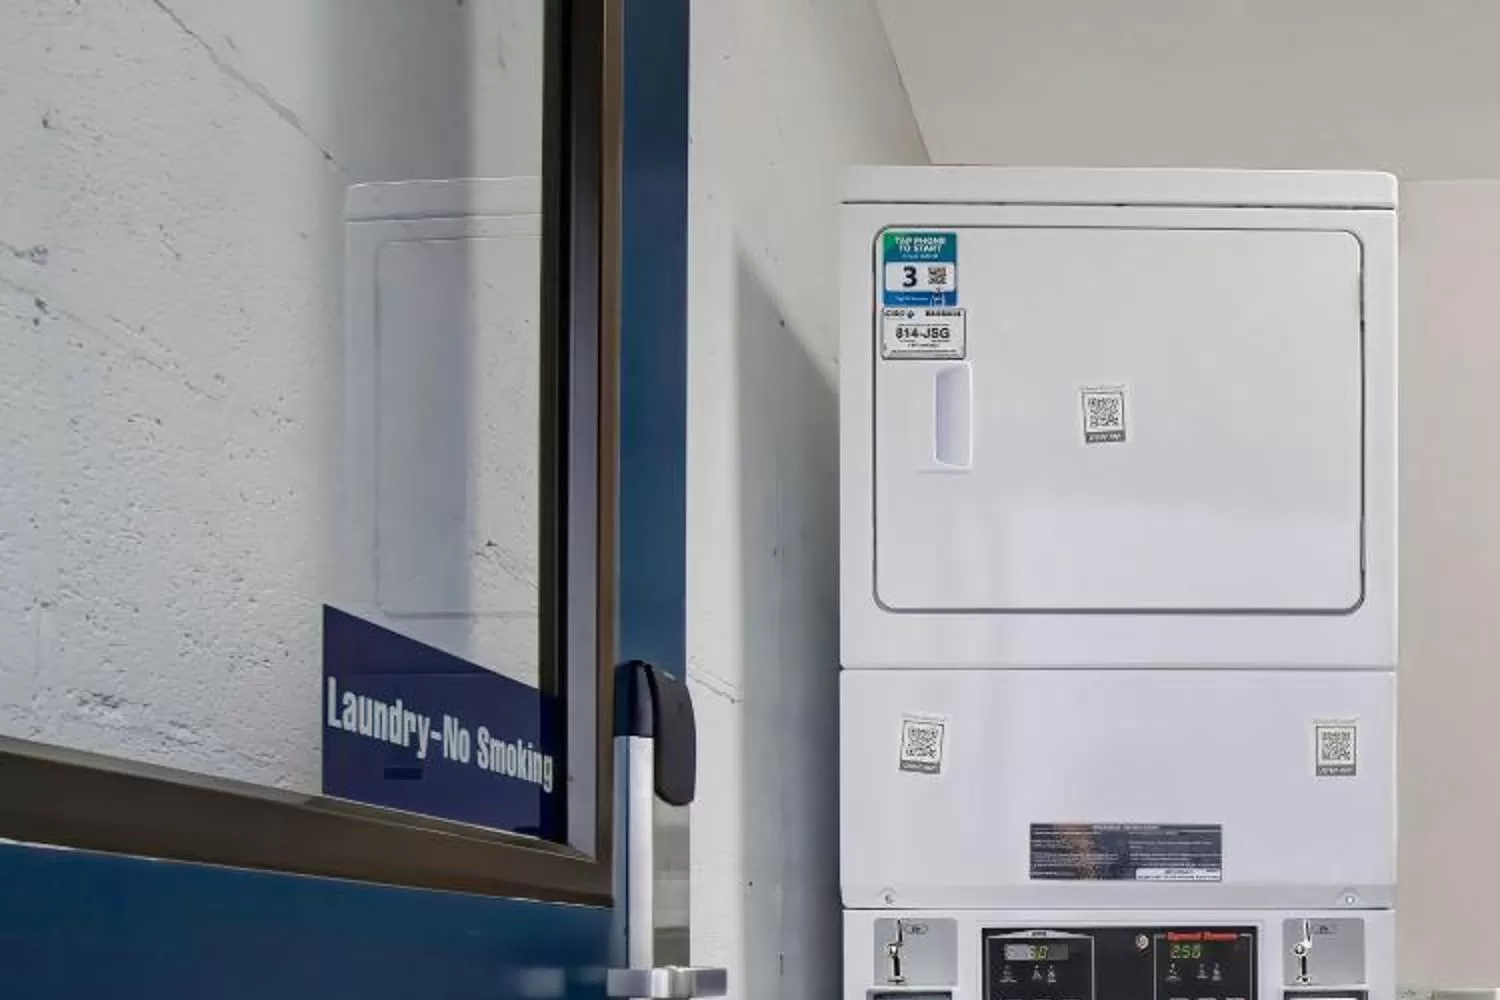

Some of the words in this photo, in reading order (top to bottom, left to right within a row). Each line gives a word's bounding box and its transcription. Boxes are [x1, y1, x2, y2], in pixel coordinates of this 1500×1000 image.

[902, 266, 918, 288] 3
[895, 327, 951, 339] 814-JSG
[477, 726, 554, 794] Smoking
